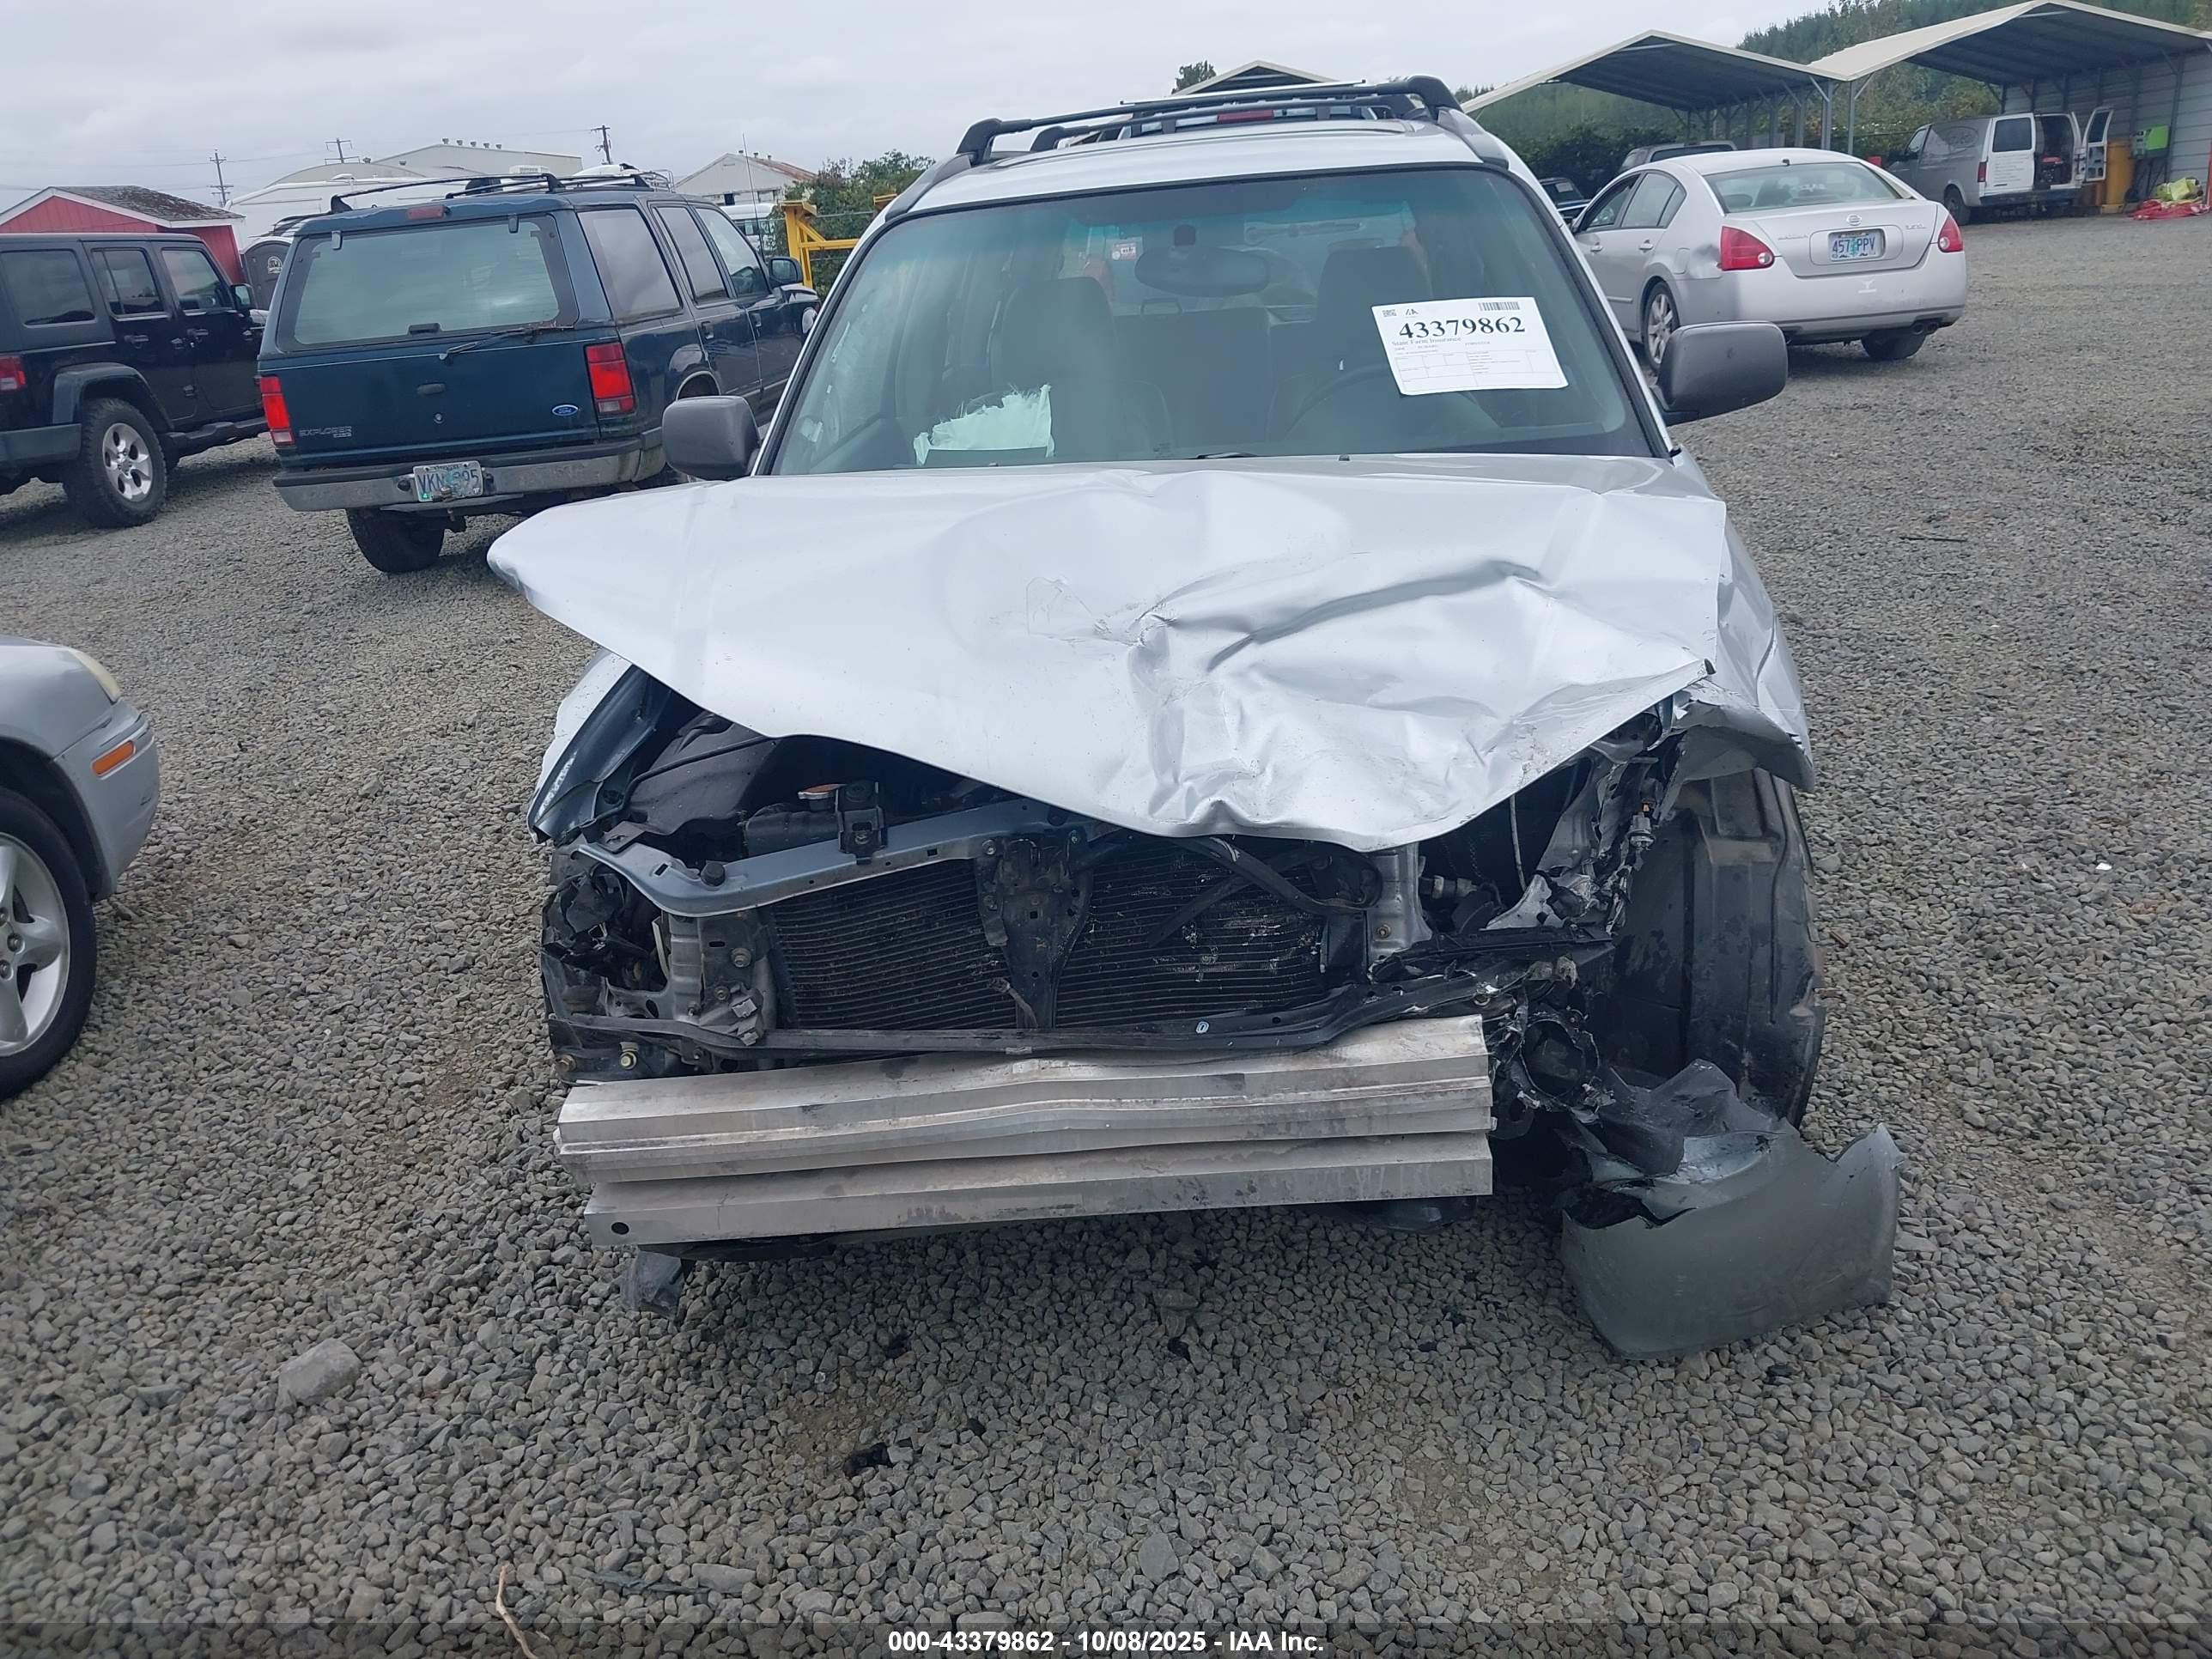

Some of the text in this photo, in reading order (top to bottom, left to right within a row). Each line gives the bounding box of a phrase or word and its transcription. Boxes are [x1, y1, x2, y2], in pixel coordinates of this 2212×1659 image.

[1832, 236, 1875, 253] 457 PPV
[1399, 317, 1526, 339] 43379862
